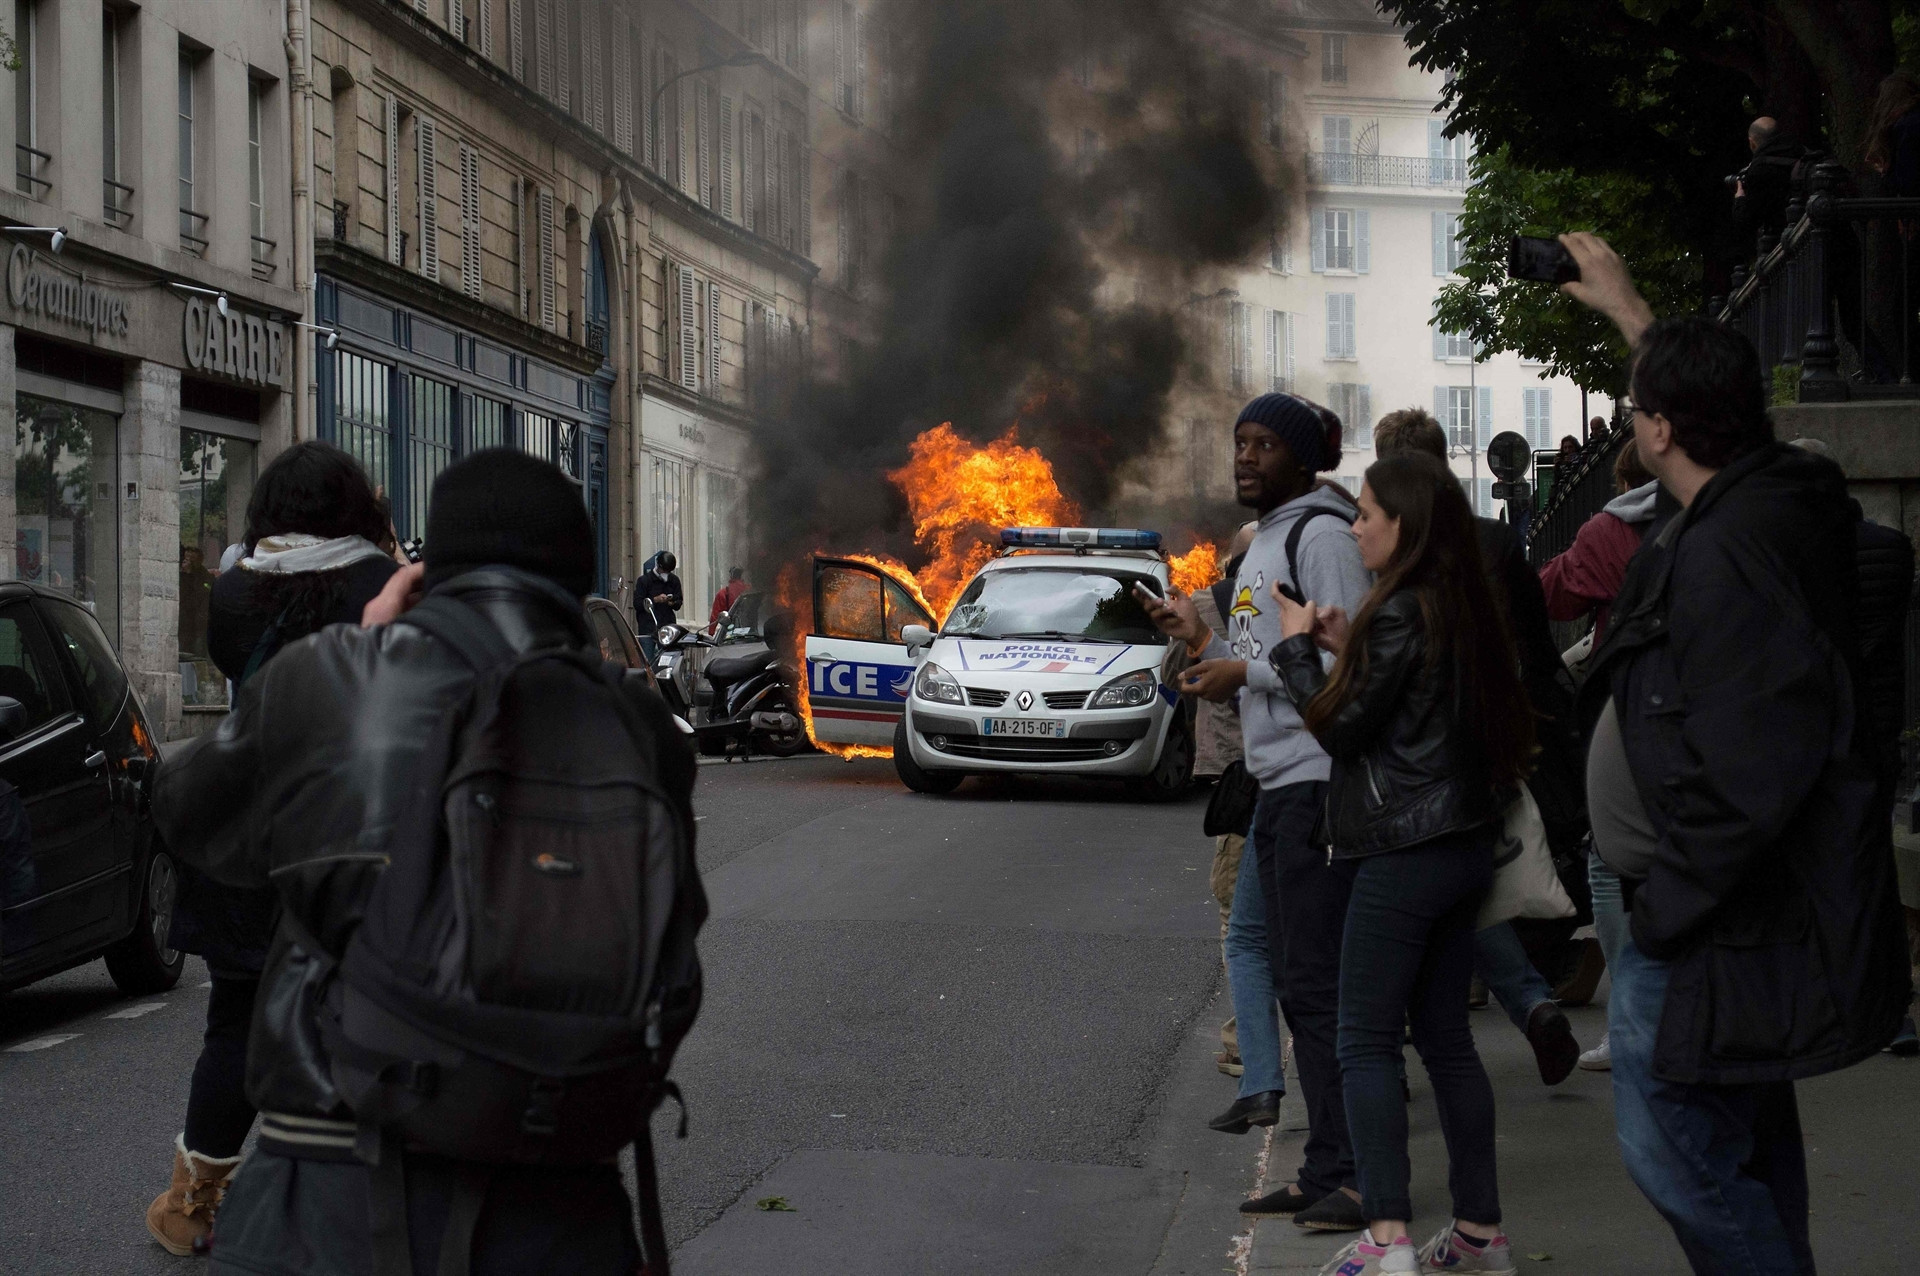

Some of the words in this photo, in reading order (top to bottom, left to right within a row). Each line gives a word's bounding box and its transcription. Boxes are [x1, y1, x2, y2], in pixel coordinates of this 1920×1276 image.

[1004, 645, 1077, 654] POLICE
[979, 652, 1097, 664] NATIONALE
[813, 661, 878, 696] ICE
[992, 720, 1055, 735] AA-215-QF
